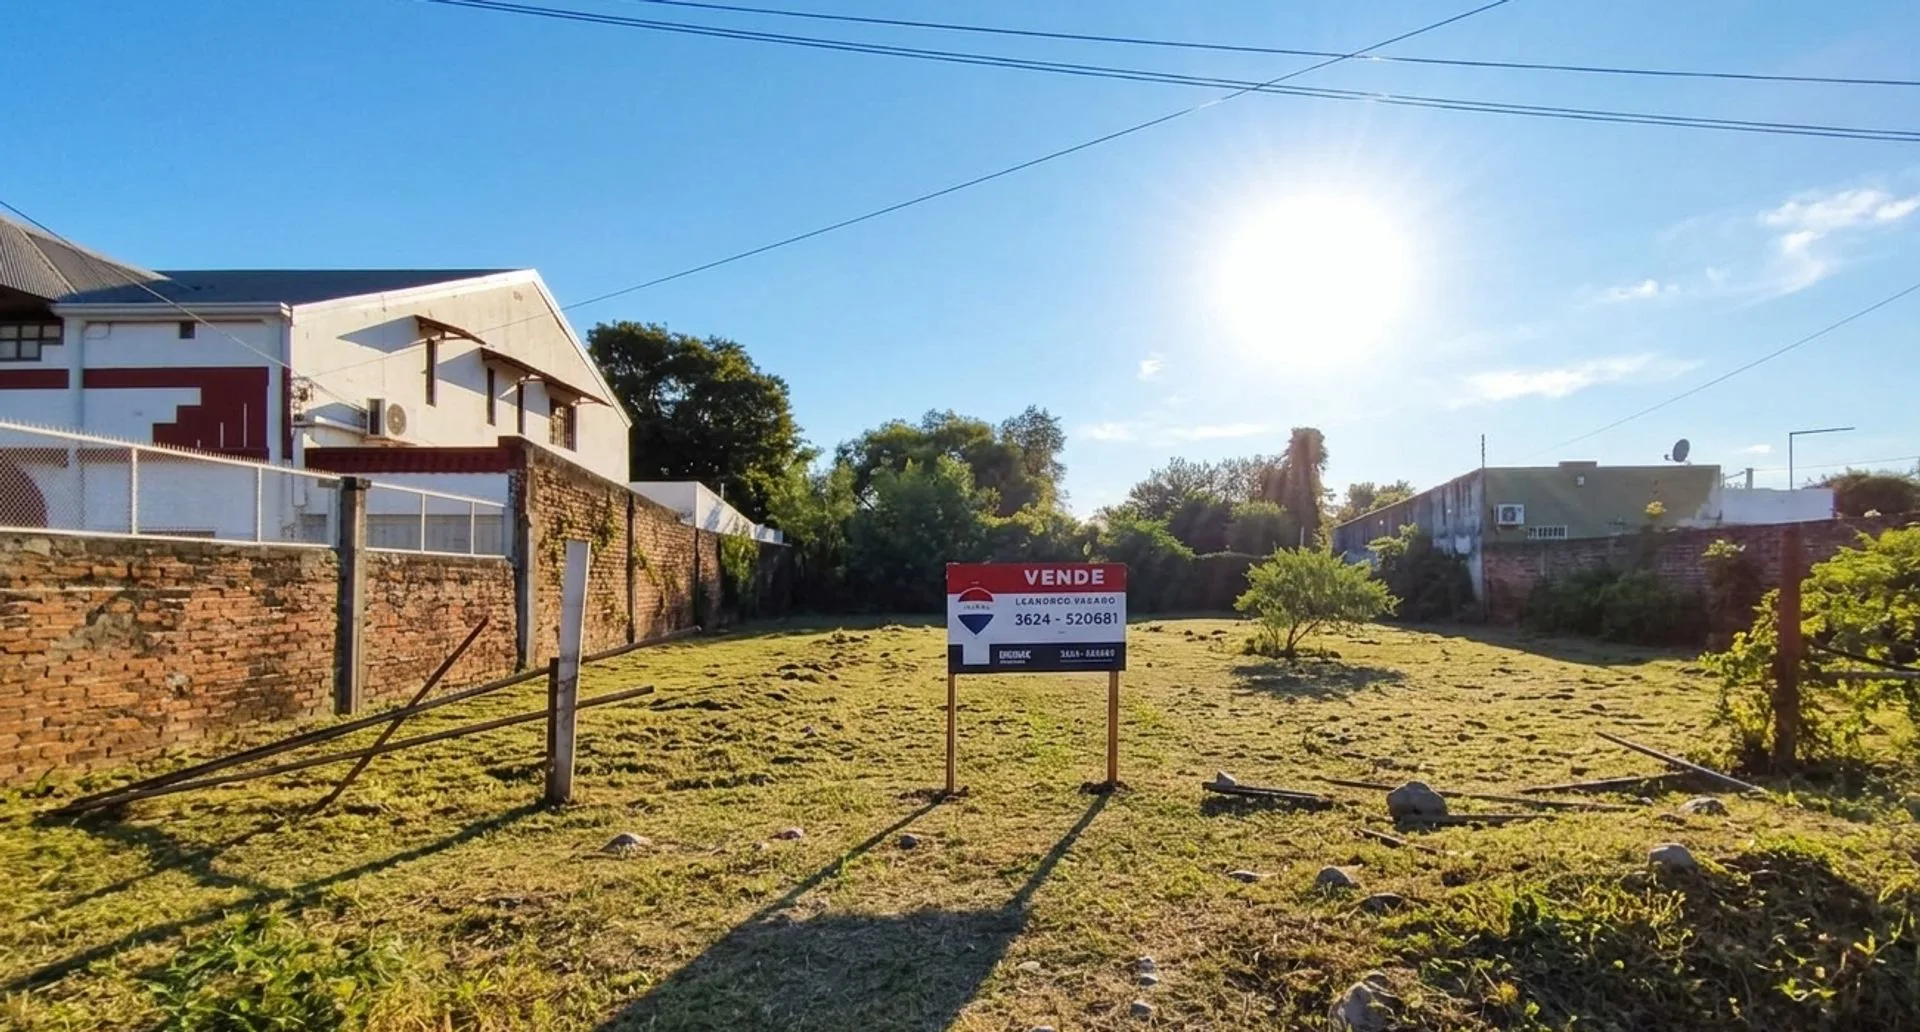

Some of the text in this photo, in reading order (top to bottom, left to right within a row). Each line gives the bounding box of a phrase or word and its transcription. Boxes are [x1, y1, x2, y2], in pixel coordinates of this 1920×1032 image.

[1024, 569, 1104, 585] VENDE
[1015, 613, 1051, 626] 3624
[1066, 612, 1118, 625] 520681
